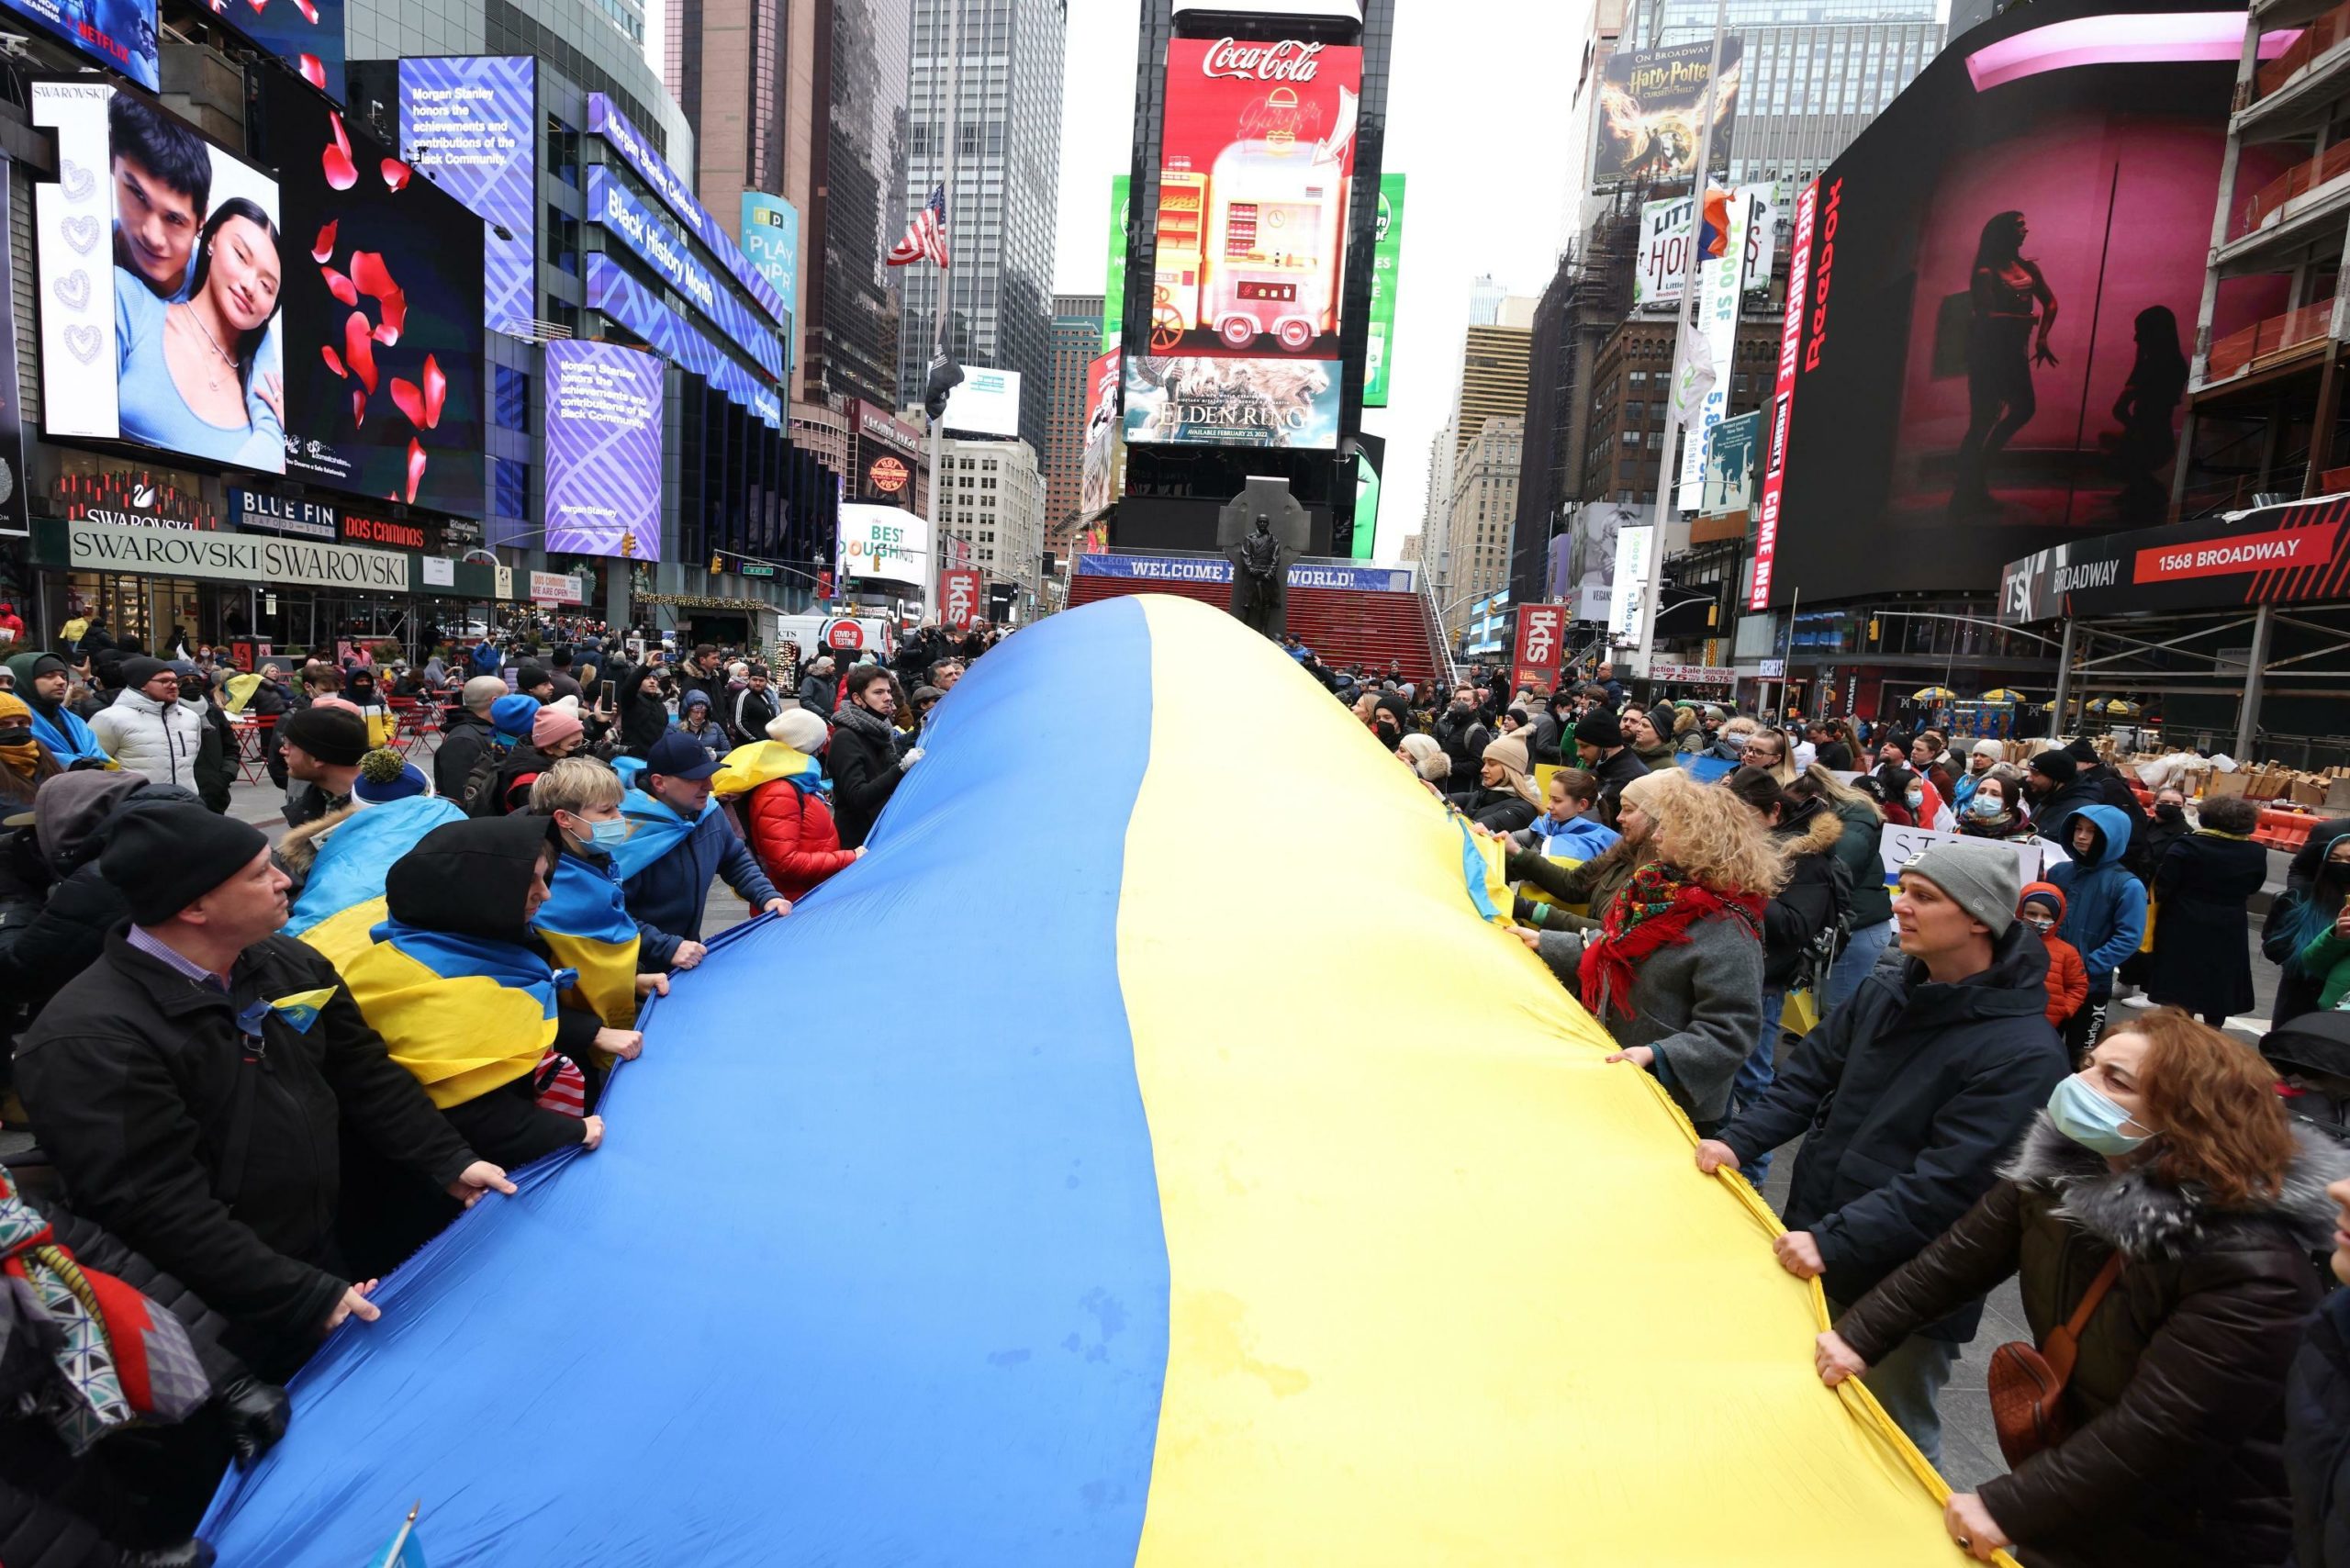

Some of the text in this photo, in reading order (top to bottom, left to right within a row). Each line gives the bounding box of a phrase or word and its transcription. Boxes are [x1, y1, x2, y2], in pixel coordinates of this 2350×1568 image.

[77, 21, 129, 64] NETFLIX
[1635, 45, 1711, 63] ON BROADWAY
[1203, 37, 1326, 82] Coca-Cola
[1627, 65, 1669, 95] Harry
[33, 85, 106, 101] SWAROVSKI
[412, 87, 494, 102] Morgan Stanley
[1643, 89, 1671, 98] CURSED
[413, 105, 469, 117] honors the
[412, 120, 508, 133] achievements and
[413, 137, 515, 149] contributions of the
[445, 153, 508, 166] Community.
[608, 110, 702, 229] Morgan Stanley Celebrates
[608, 186, 713, 308] Black History Month
[1805, 176, 1843, 374] Reebok
[1779, 247, 1810, 383] CHOCOLATE
[561, 359, 636, 382] Morgan Stanley
[561, 373, 613, 386] honors the
[560, 386, 647, 406] achievements and
[560, 398, 652, 420] contributions of the
[560, 408, 646, 431] Black Community.
[1159, 401, 1307, 430] ELDEN RING
[880, 459, 899, 468] HOT
[1685, 437, 1698, 476] SIGNAGE
[879, 480, 899, 488] NOW
[242, 491, 334, 526] BLUE FIN
[560, 504, 618, 519] Morgan Stanley
[243, 513, 335, 538] SEAFOOD SUSHI
[344, 516, 371, 540] DOS
[373, 521, 424, 548] CAMINOS
[871, 524, 904, 543] BEST
[1758, 489, 1779, 556] COME
[73, 531, 259, 570] SWAROVSKI
[2158, 538, 2300, 572] 1568 BROADWAY
[264, 543, 407, 587] SWAROVSKI
[1130, 561, 1223, 580] WELCOME
[534, 576, 566, 586] DOS CAMINOS
[2053, 559, 2120, 595] BROADWAY
[532, 585, 541, 595] WE
[542, 586, 553, 595] ARE
[553, 587, 568, 597] OPEN
[948, 575, 974, 626] tkts
[2006, 555, 2034, 623] TSX
[778, 630, 797, 638] CTS
[834, 630, 857, 638] COVID-19
[834, 637, 856, 645] TESTING
[1526, 610, 1558, 664] tkts
[1681, 666, 1701, 674] Sale
[1759, 659, 1784, 677] HERSHEY'S
[1845, 675, 1857, 714] ADAME
[2083, 1016, 2105, 1049] Hurley
